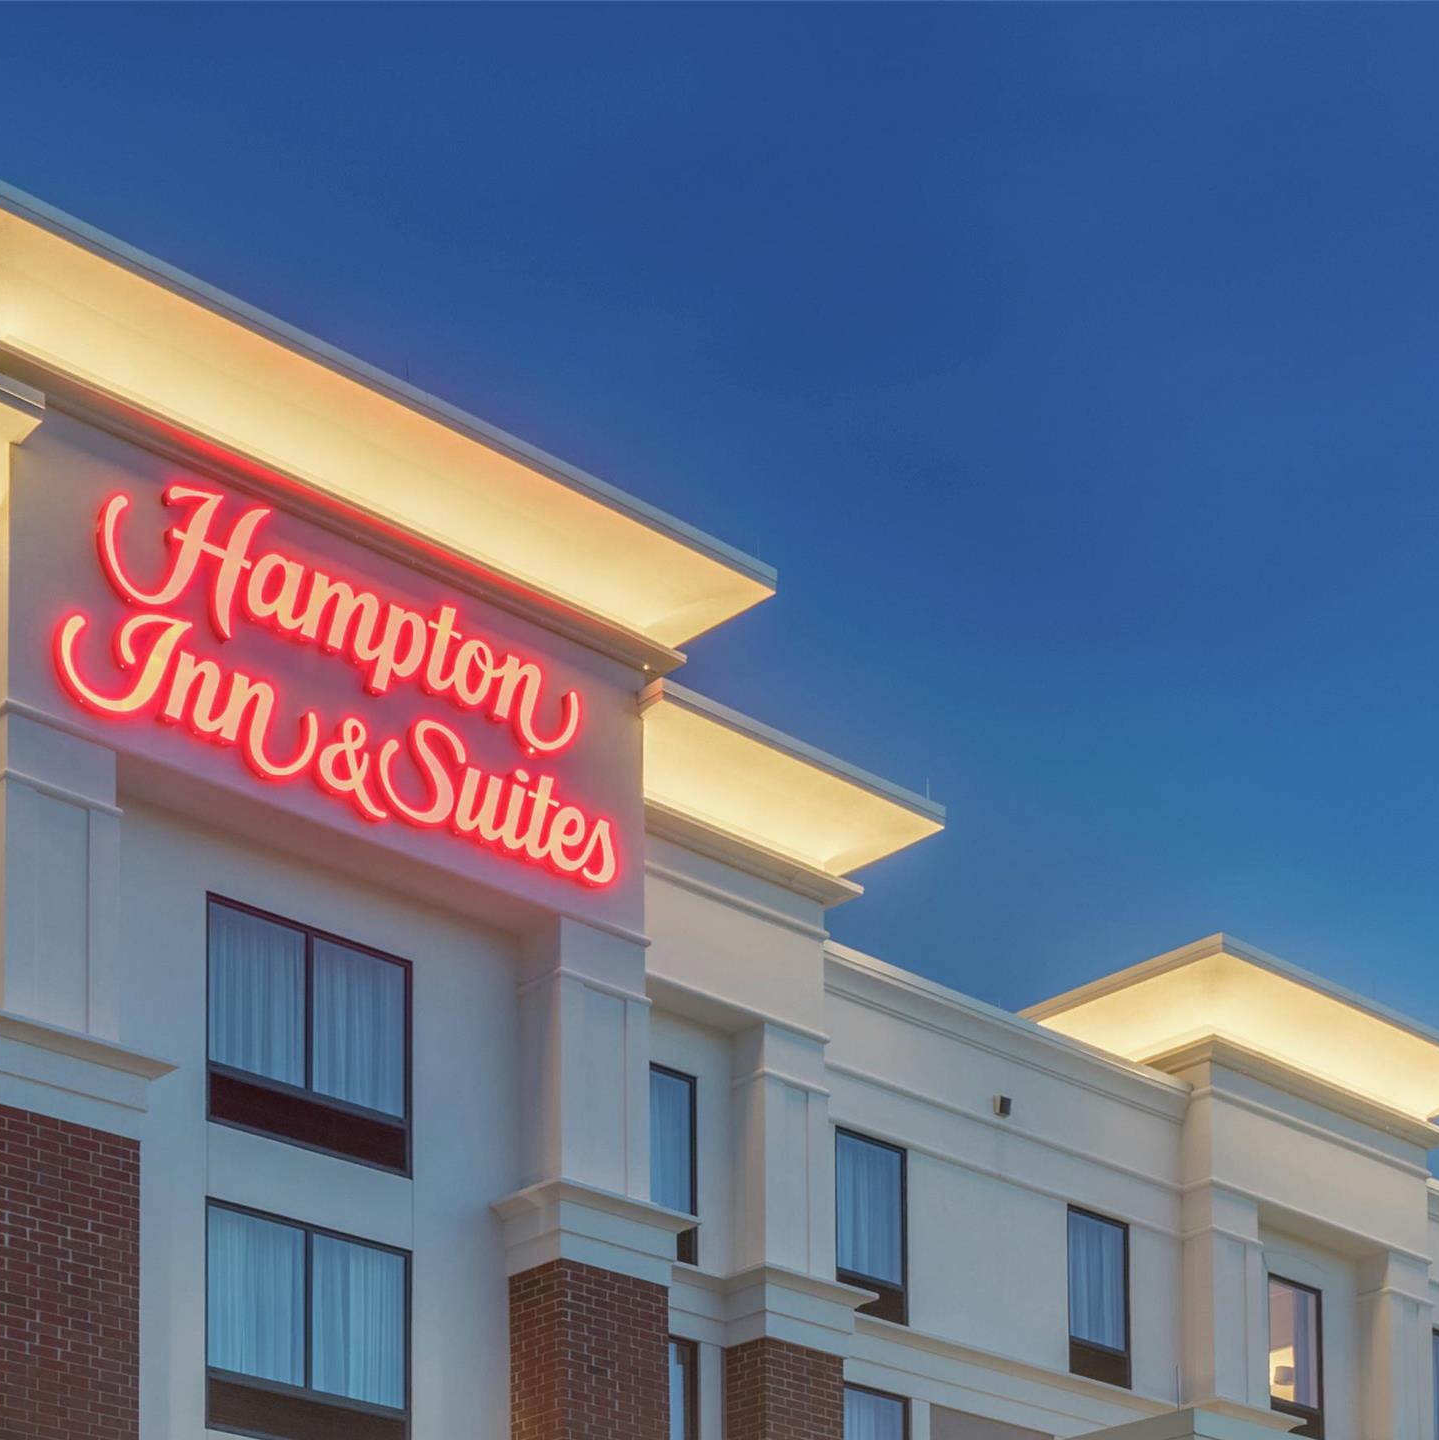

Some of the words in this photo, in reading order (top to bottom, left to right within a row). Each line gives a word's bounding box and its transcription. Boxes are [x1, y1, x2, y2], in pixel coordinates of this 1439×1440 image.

[56, 612, 320, 778] Inn
[317, 717, 388, 821] &
[378, 719, 618, 887] Suites
[98, 484, 579, 754] Hampton
